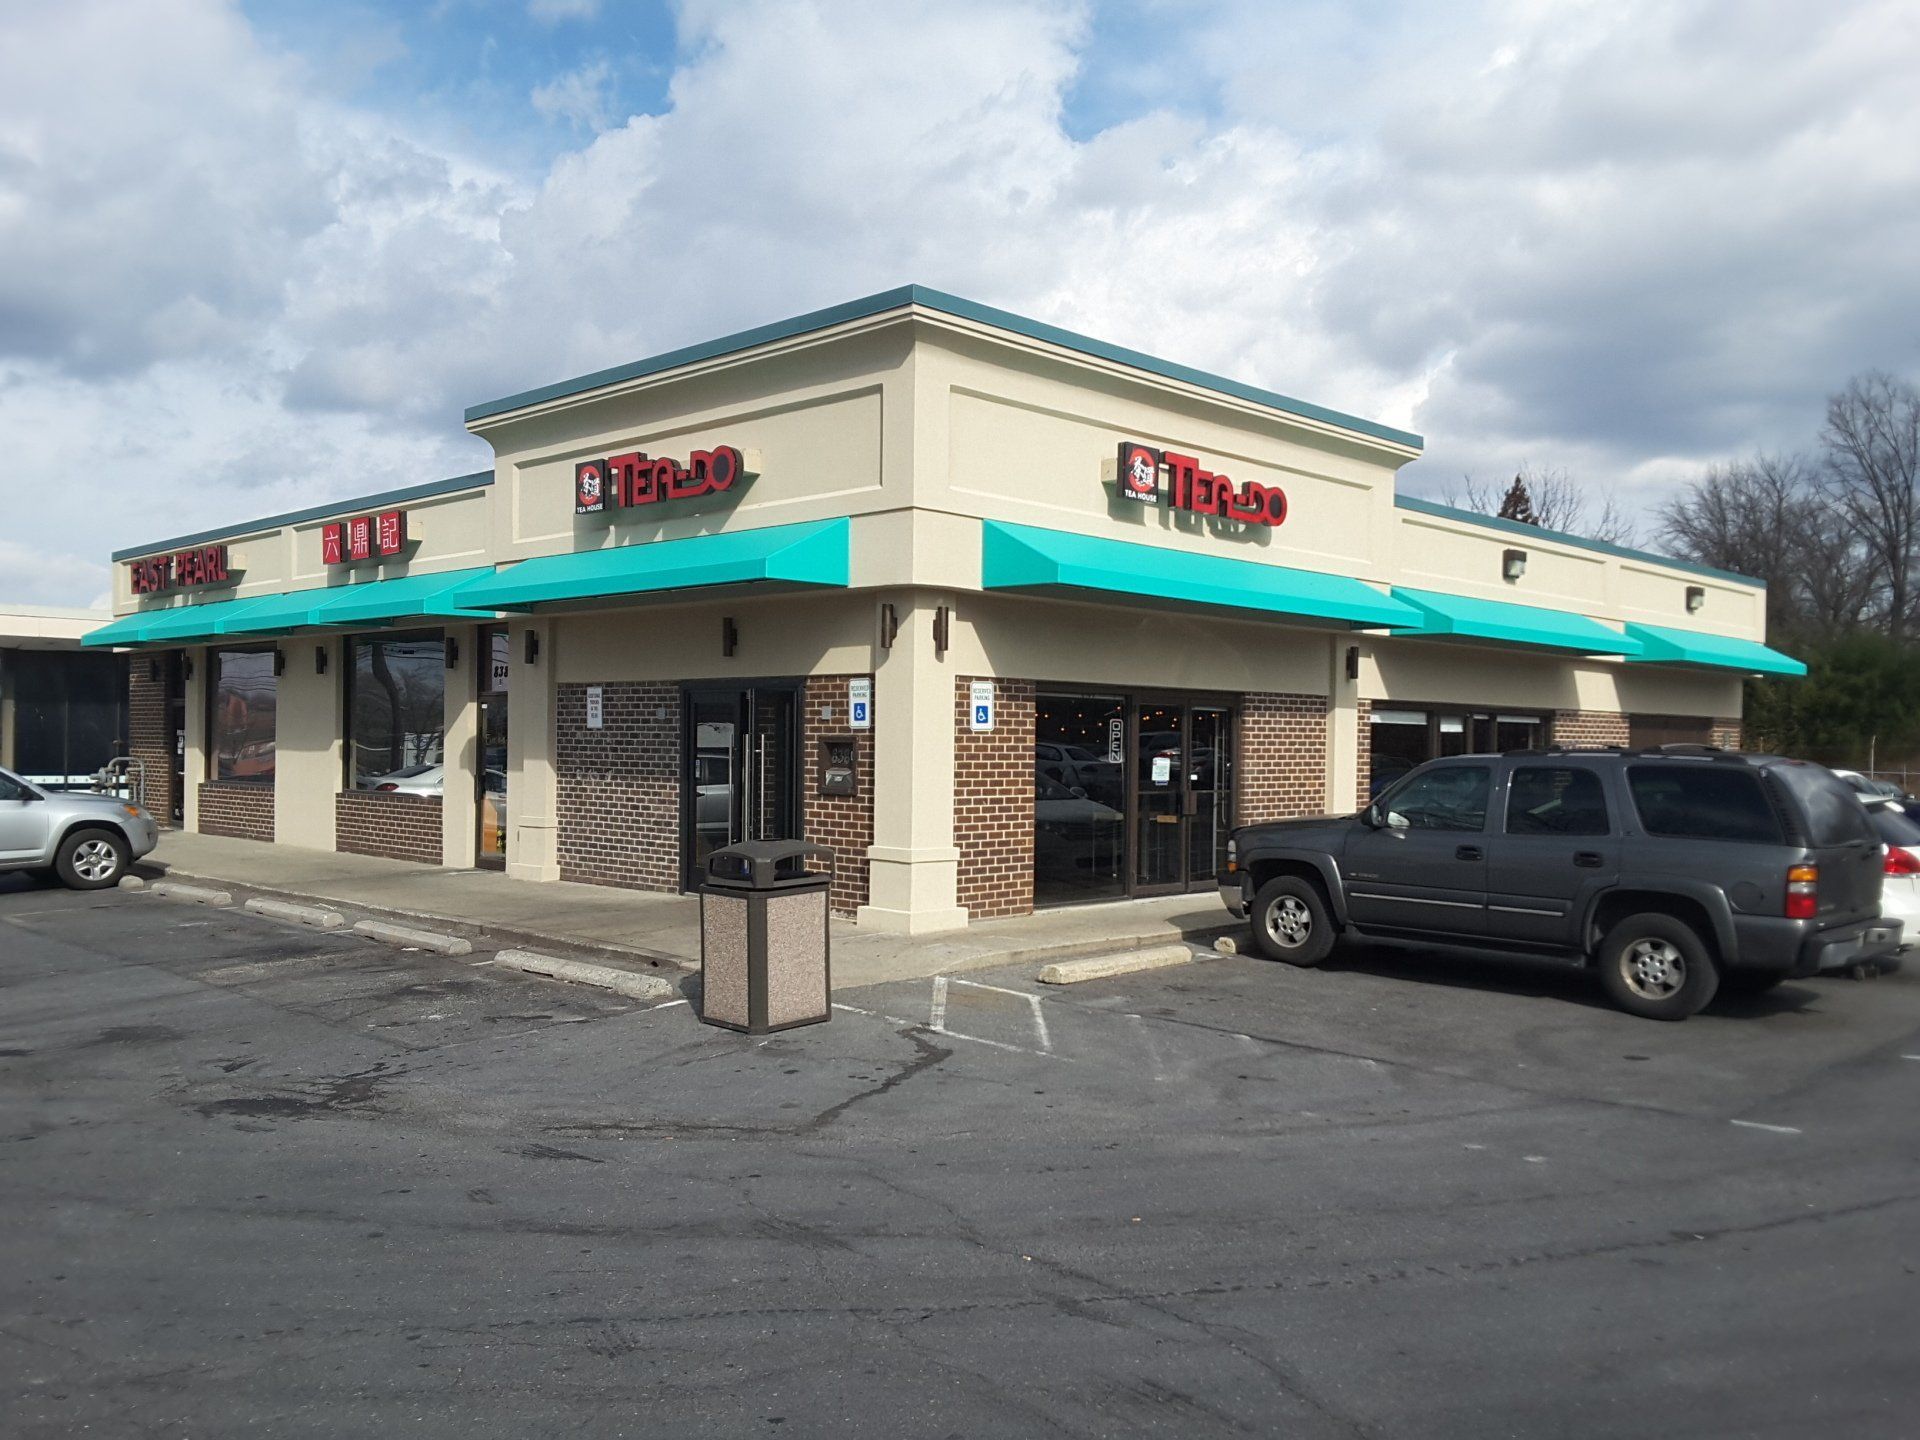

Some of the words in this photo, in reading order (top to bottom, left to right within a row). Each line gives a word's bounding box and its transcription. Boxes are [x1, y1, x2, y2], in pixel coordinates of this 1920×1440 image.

[608, 445, 738, 508] TEA-DO
[1125, 489, 1137, 498] TEA
[1137, 492, 1157, 503] HOUSE
[1164, 451, 1288, 527] TEA-DO
[586, 503, 603, 511] HOUSE
[324, 518, 399, 559] 六鼎記
[131, 555, 168, 594] EAST
[176, 545, 229, 587] PEARL
[1112, 722, 1120, 760] OPEN
